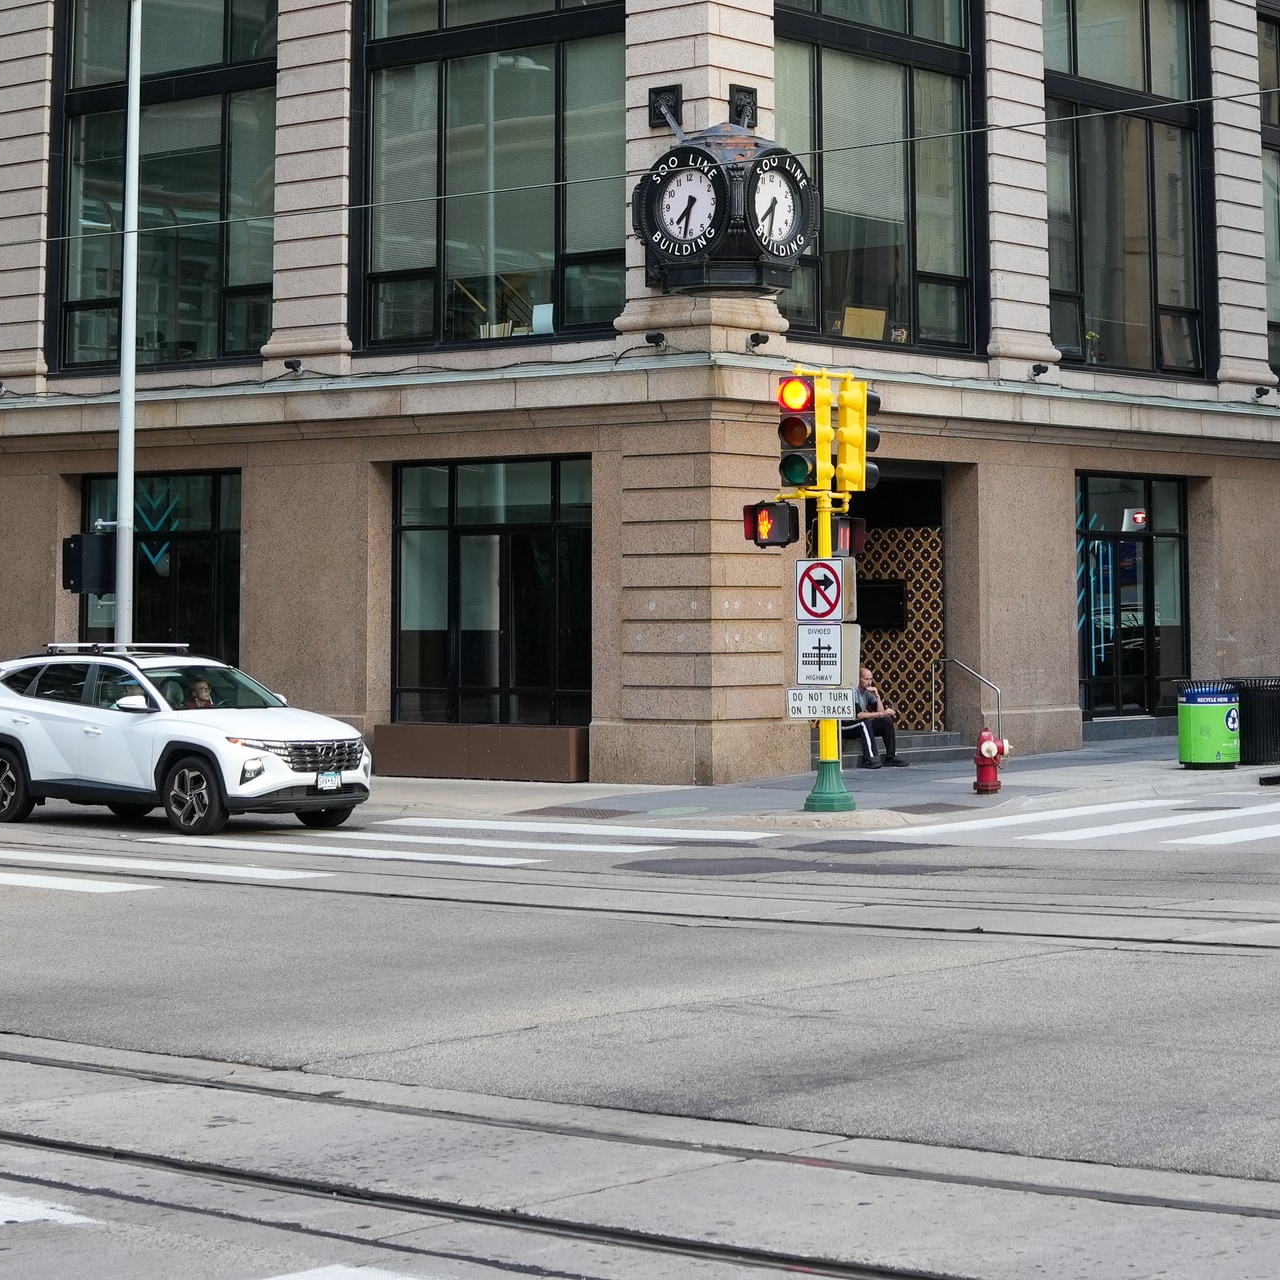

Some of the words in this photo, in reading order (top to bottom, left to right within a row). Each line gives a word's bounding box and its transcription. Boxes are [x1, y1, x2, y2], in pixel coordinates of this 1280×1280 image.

[652, 156, 678, 184] SOO
[688, 154, 718, 180] LINE
[686, 173, 693, 182] 12
[756, 155, 778, 178] SOO
[785, 158, 807, 189] LINE
[668, 190, 676, 198] 10
[652, 227, 715, 255] BUILDING
[755, 226, 804, 257] BUILDING
[792, 693, 803, 702] DO
[808, 692, 823, 701] NOT
[828, 692, 849, 701] TURN
[791, 706, 802, 715] ON
[807, 706, 817, 714] TO
[822, 705, 852, 715] TRACKS
